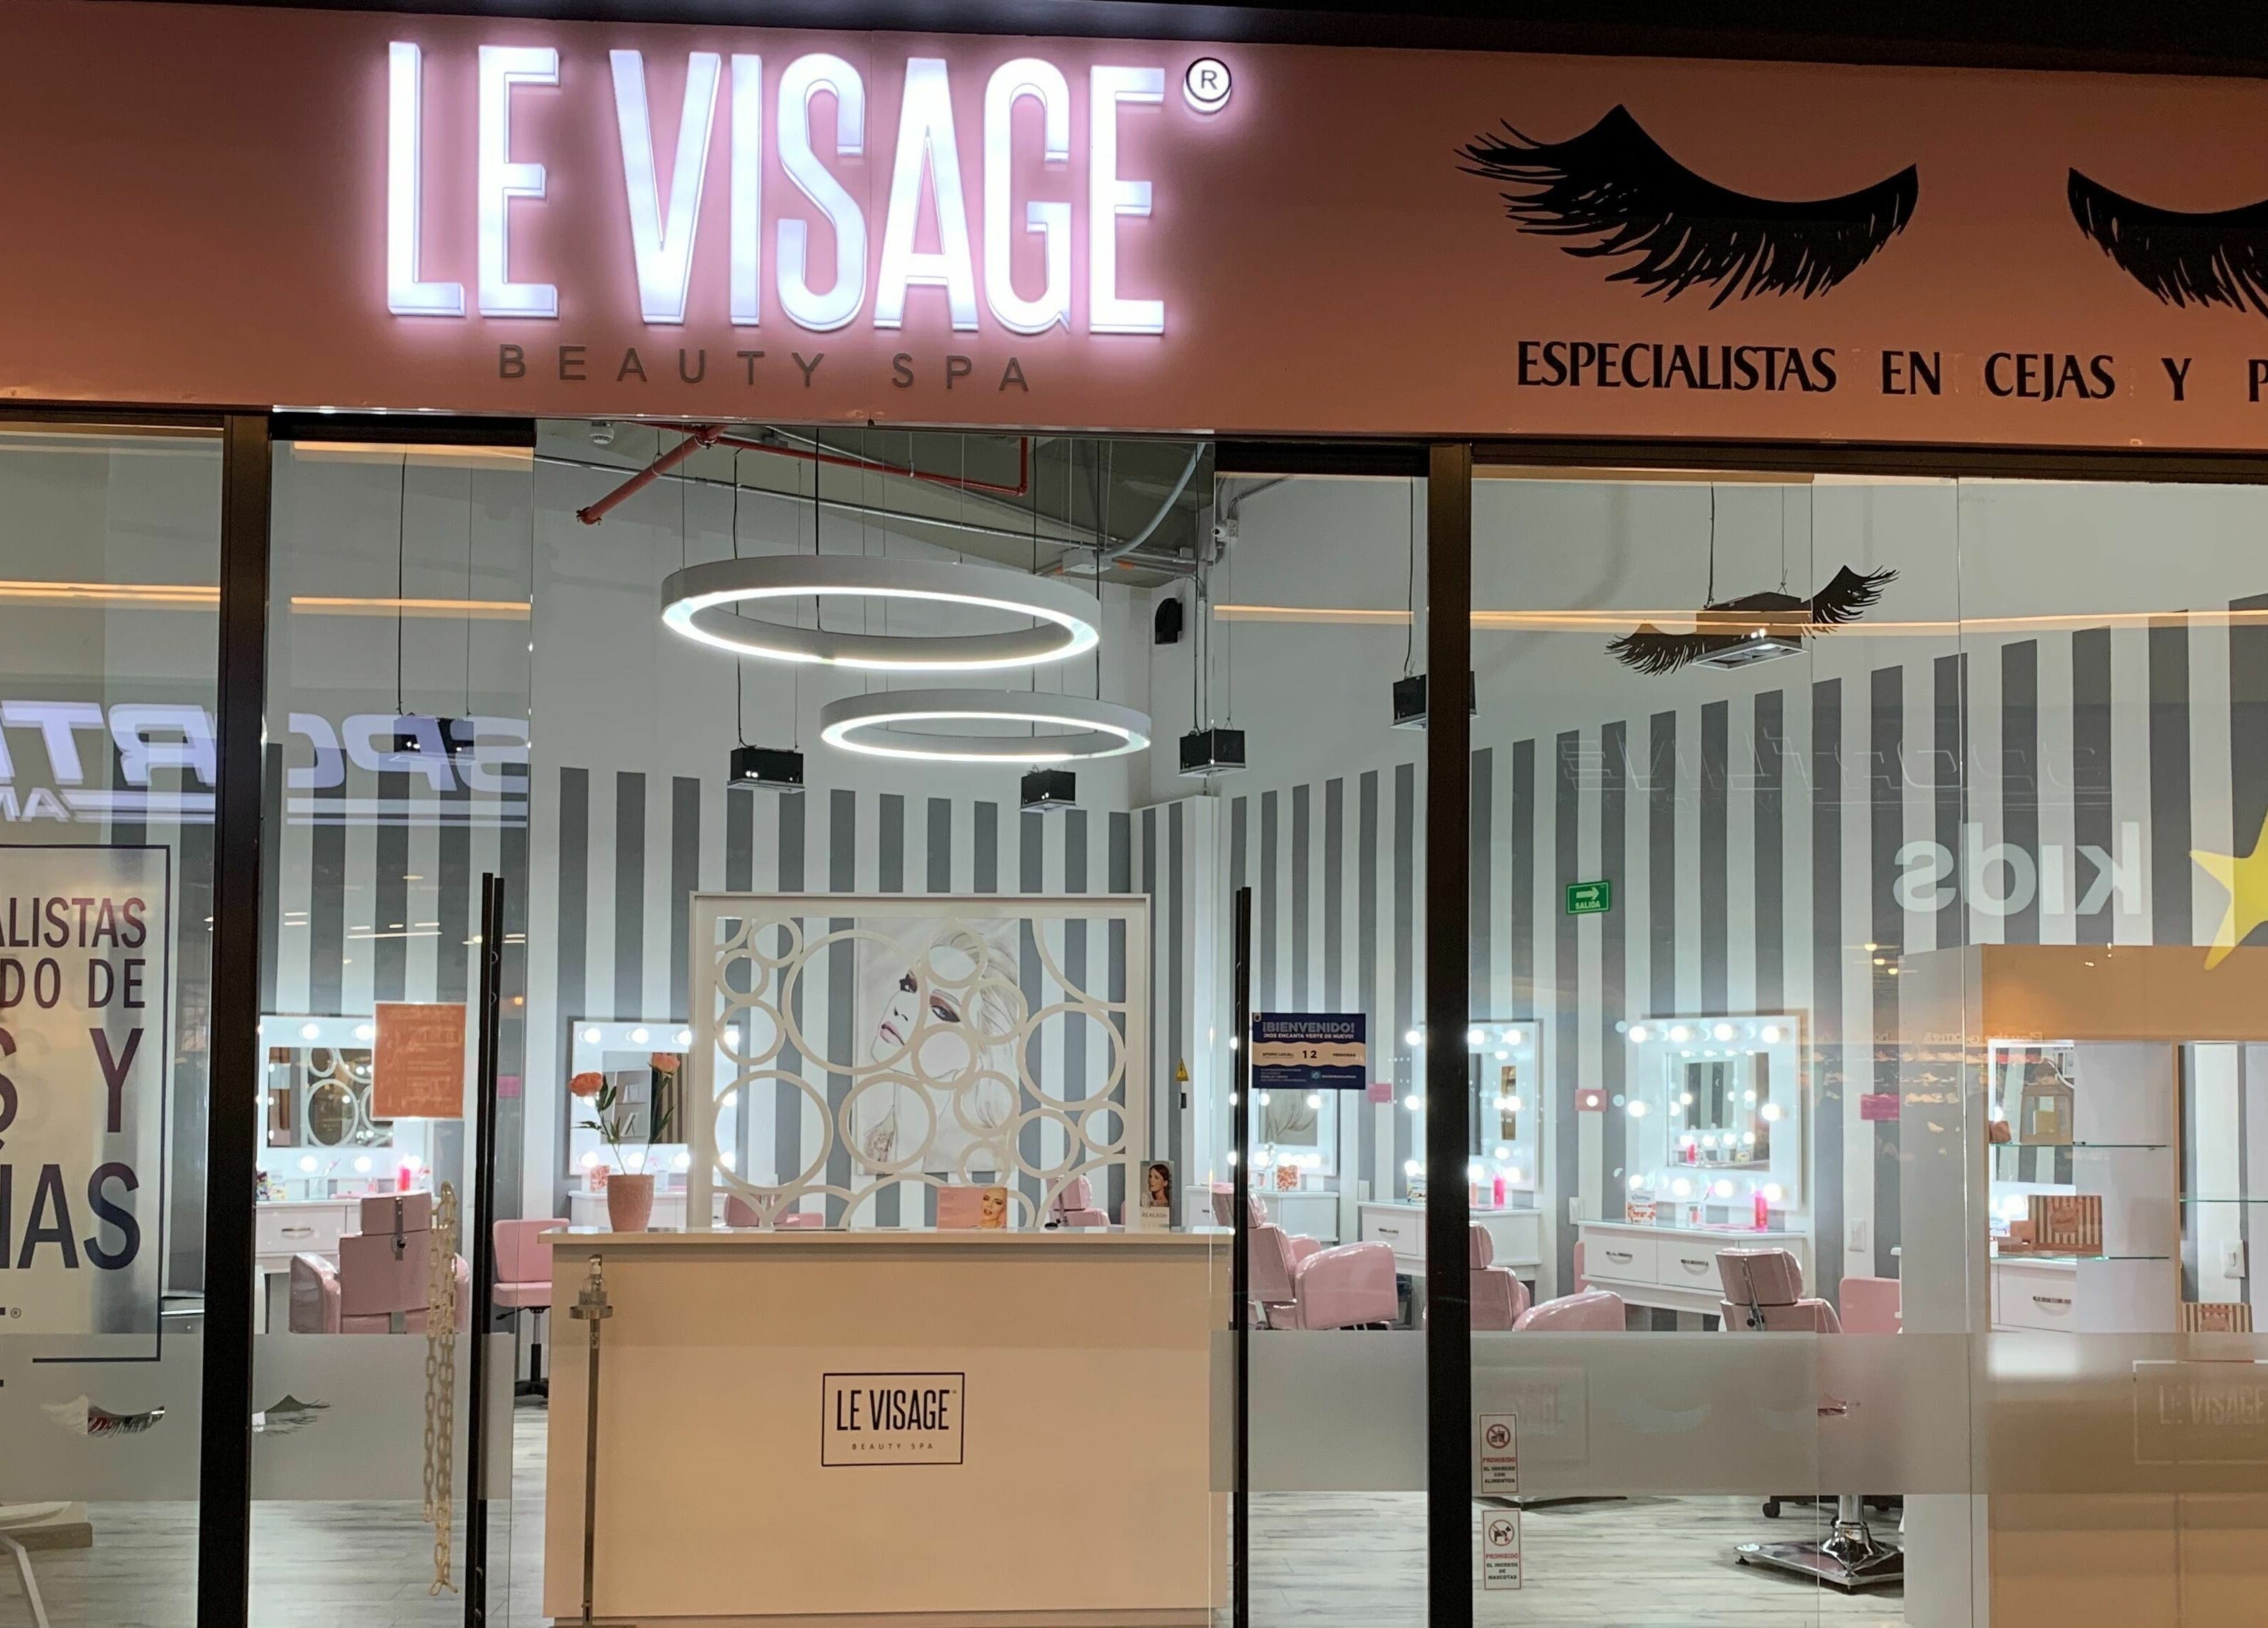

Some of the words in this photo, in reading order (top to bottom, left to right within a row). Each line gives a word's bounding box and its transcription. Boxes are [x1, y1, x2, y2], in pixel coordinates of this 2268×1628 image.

[388, 41, 561, 317] LE
[609, 49, 1165, 334] VISAGE
[499, 344, 825, 388] BEAUTY
[891, 352, 1029, 393] SPA
[1517, 340, 1837, 393] ESPECIALISTAS
[1882, 351, 1941, 396] EN
[1985, 352, 2116, 402] CEJAS
[2162, 357, 2193, 402] Y
[0, 897, 147, 948] LISTAS
[1575, 900, 1601, 910] SALIDA
[0, 957, 61, 1009] DO
[88, 958, 146, 1009] DE
[89, 1027, 144, 1133] Y
[836, 1390, 862, 1431] LE
[869, 1390, 950, 1431] VISAGE
